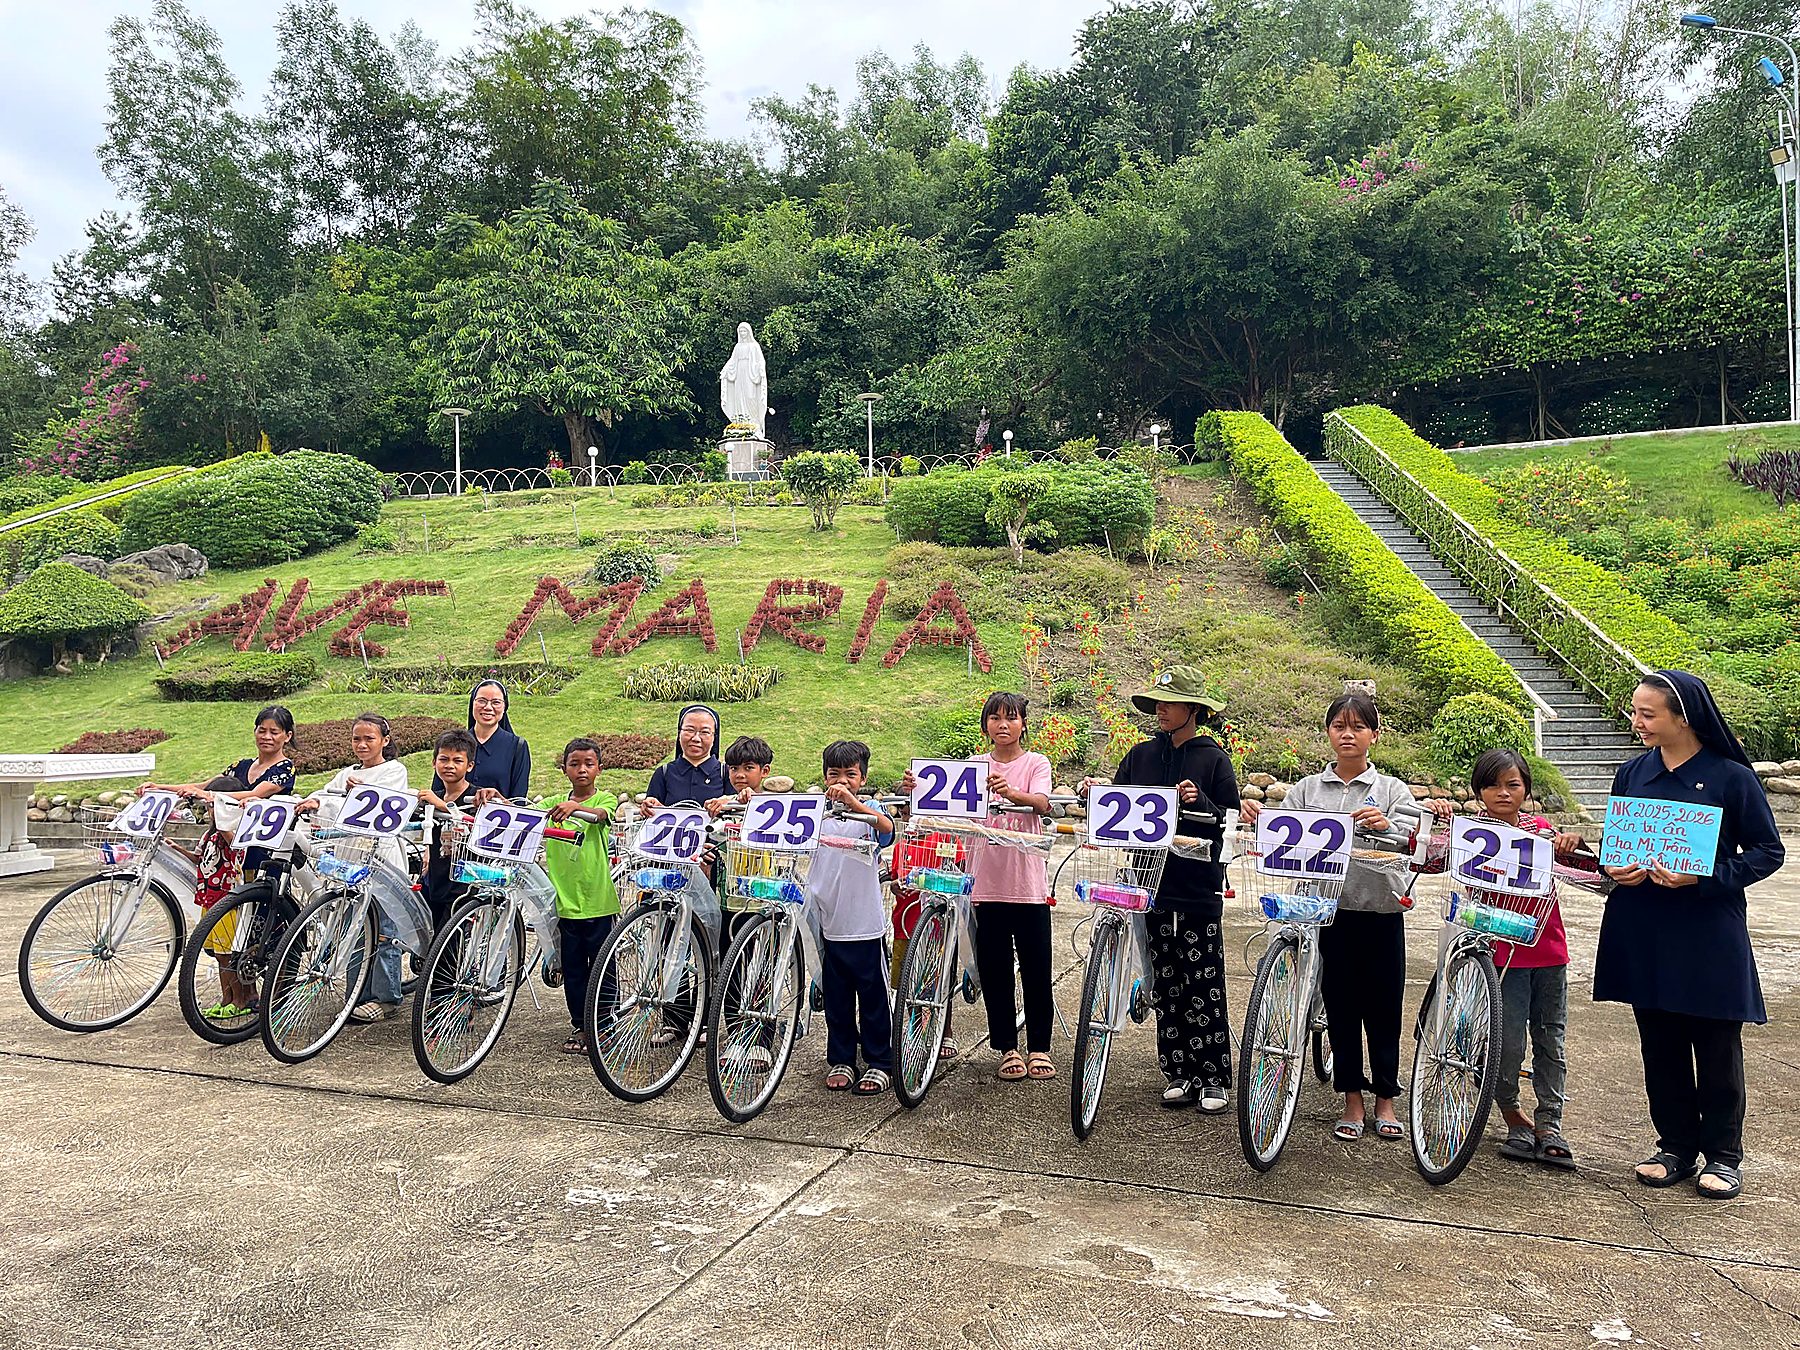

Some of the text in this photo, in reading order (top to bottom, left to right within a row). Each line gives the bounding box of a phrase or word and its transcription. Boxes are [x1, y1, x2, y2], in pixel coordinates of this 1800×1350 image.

[153, 575, 994, 673] AVE MARIA
[917, 764, 984, 813] 24
[127, 796, 172, 832] 30
[239, 804, 288, 843] 29
[344, 790, 409, 833] 28
[475, 809, 543, 857] 27
[747, 799, 818, 846] 25
[1095, 791, 1169, 843] 23
[1608, 818, 1687, 837] Xin tri ân
[1611, 801, 1716, 826] NK 2025-2026
[640, 813, 704, 858] 26
[1263, 815, 1347, 875] 22
[1606, 835, 1634, 851] Cha
[1637, 837, 1655, 853] Mi
[1459, 828, 1541, 890] 21
[1605, 850, 1623, 864] và
[1673, 857, 1710, 875] Nhân
